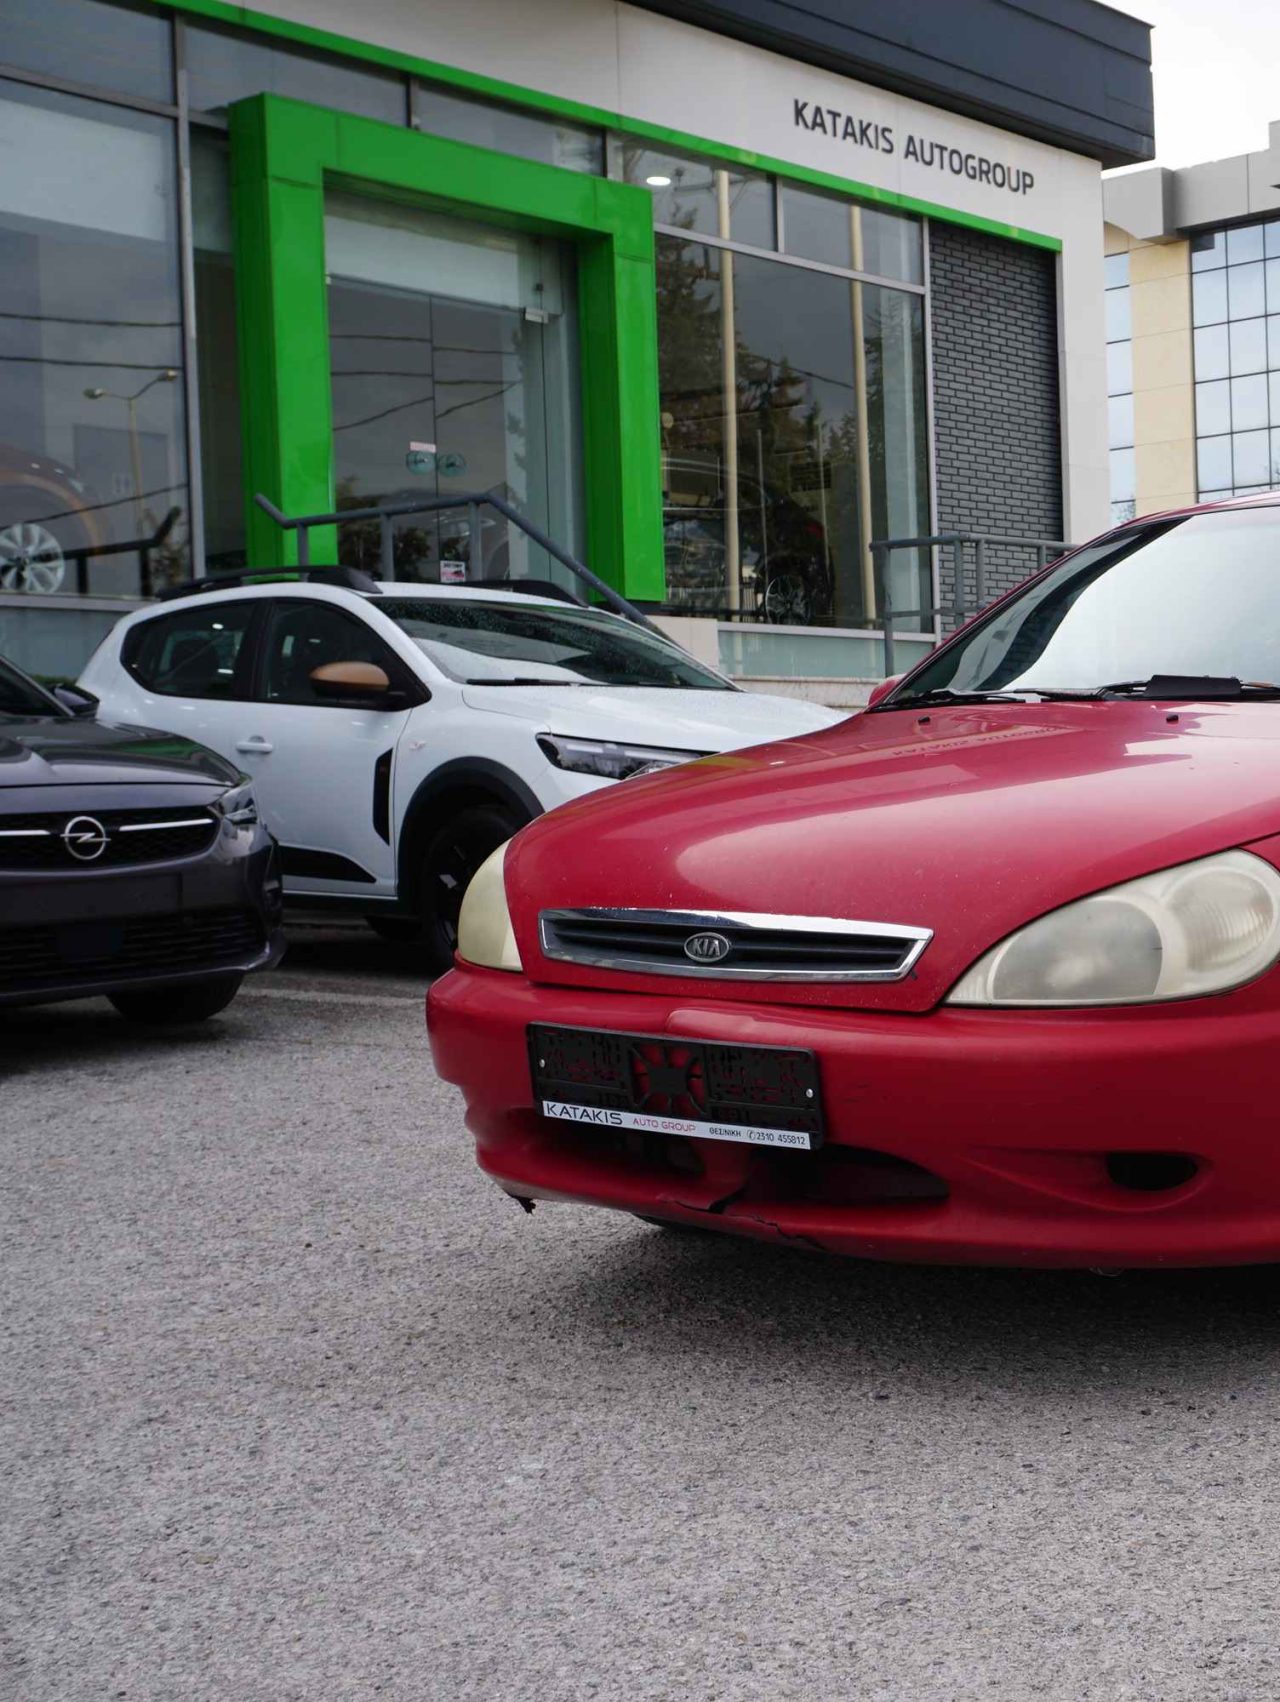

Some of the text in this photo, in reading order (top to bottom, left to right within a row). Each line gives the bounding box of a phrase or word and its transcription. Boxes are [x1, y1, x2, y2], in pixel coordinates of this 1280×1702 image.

[794, 99, 1034, 195] KATAKIS AUTOGROUP
[692, 938, 721, 956] KIA
[546, 1102, 623, 1125] KATAKIS
[632, 1117, 659, 1128] AUTO
[661, 1121, 696, 1132] GROUP
[756, 1131, 775, 1142] 2310
[777, 1134, 806, 1145] 455812
